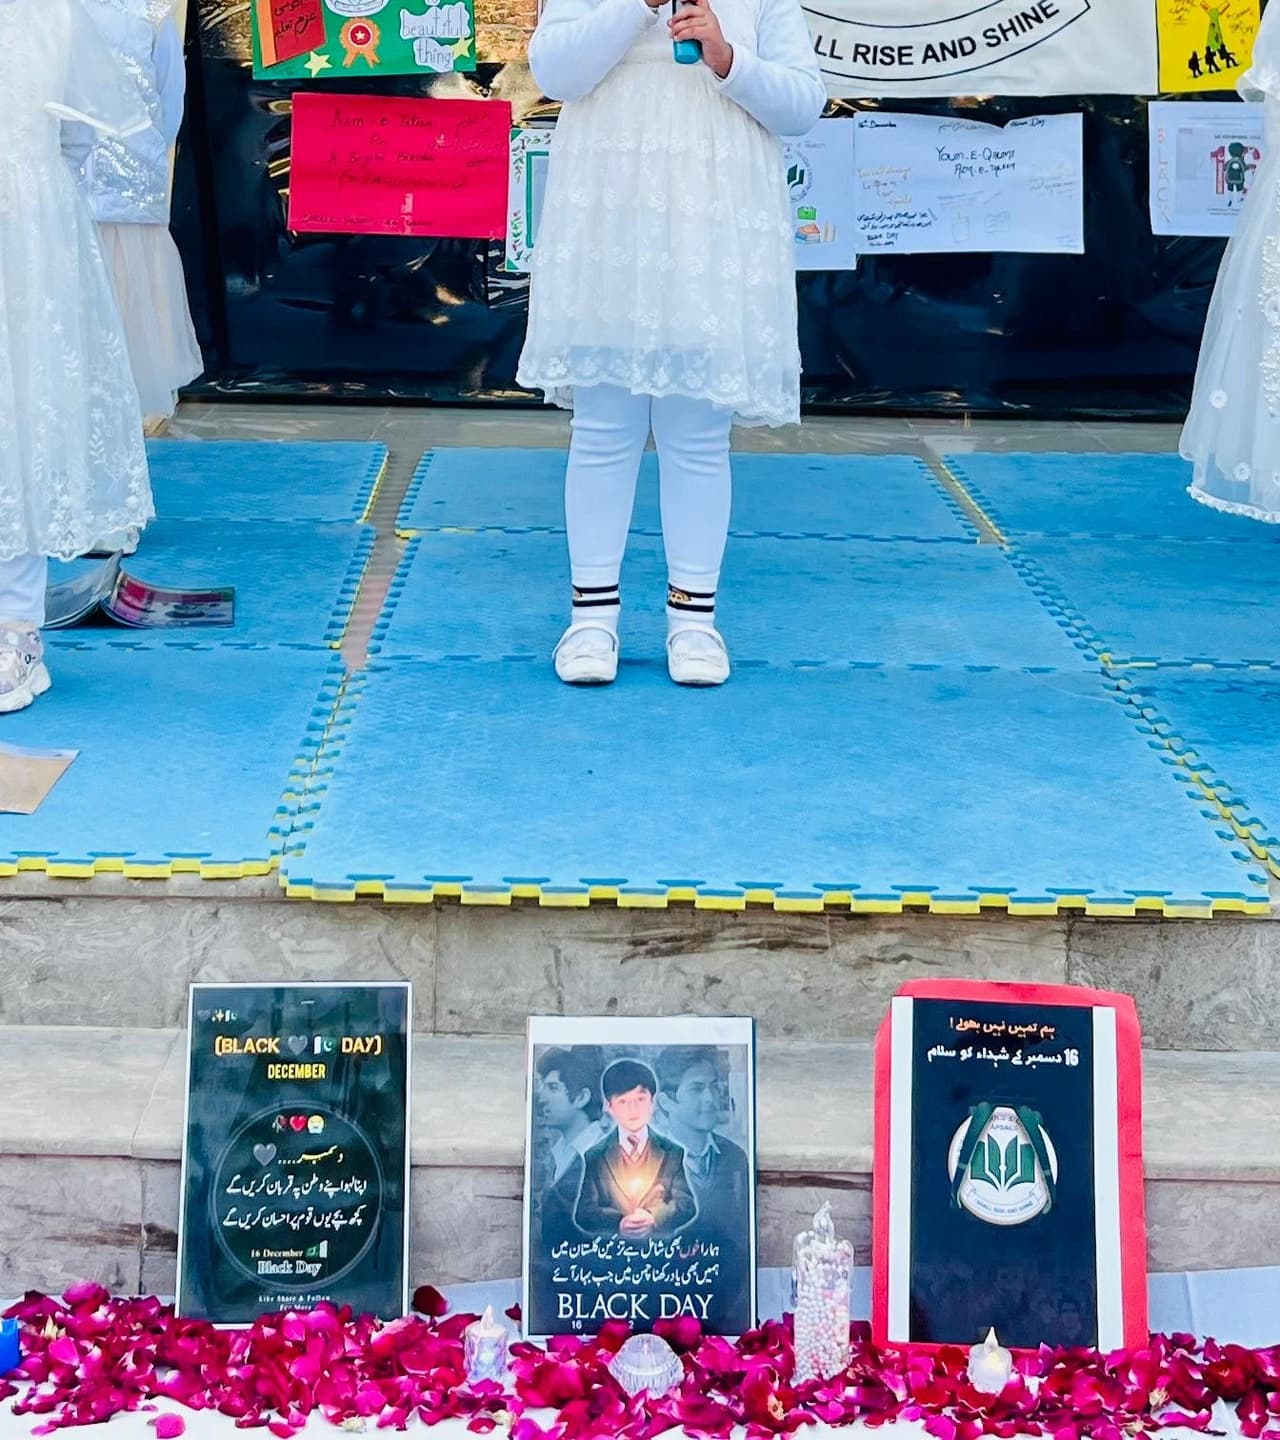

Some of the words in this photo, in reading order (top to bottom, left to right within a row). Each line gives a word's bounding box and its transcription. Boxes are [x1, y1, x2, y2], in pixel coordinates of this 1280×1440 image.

[403, 3, 468, 36] beautiful
[852, 43, 915, 66] RISE
[921, 35, 977, 65] AND
[955, 1017, 981, 1034] بھولے
[983, 1020, 1006, 1037] نہیں
[1008, 1022, 1038, 1038] تمہیں
[1039, 1023, 1056, 1040] ہم
[927, 1044, 956, 1062] سلام
[960, 1046, 973, 1062] کو
[976, 1046, 1010, 1068] شہداء
[1011, 1048, 1023, 1066] کے
[1025, 1052, 1062, 1069] دسمبر
[1063, 1048, 1079, 1067] 16
[267, 1063, 327, 1080] DECEMBER
[226, 1174, 242, 1193] گے
[241, 1172, 272, 1198] کریں
[266, 1174, 294, 1196] قربان
[301, 1172, 323, 1195] وطن
[325, 1179, 344, 1199] اپنے
[223, 1207, 237, 1227] گے
[238, 1206, 268, 1230] کریں
[261, 1212, 291, 1229] احسان
[289, 1214, 299, 1231] پر
[297, 1206, 315, 1231] قوم
[313, 1212, 332, 1229] یوں
[331, 1210, 348, 1231] بچے
[349, 1204, 368, 1226] کچھ
[251, 1248, 261, 1258] 16
[263, 1248, 304, 1258] December
[552, 1239, 569, 1259] میں
[569, 1235, 602, 1259] گلستان
[623, 1244, 640, 1262] ہے
[640, 1238, 665, 1259] شامل
[665, 1235, 683, 1259] بھی
[700, 1243, 720, 1258] ہمارا
[257, 1260, 293, 1275] Black
[295, 1260, 322, 1278] Day
[552, 1264, 578, 1283] آئے
[574, 1267, 593, 1286] بہار
[614, 1266, 632, 1285] میں
[631, 1263, 652, 1284] چمن
[682, 1261, 700, 1285] بھی
[696, 1263, 720, 1284] ہمیں
[557, 1293, 651, 1320] BLACK
[659, 1293, 714, 1320] DAY
[572, 1320, 582, 1329] 16
